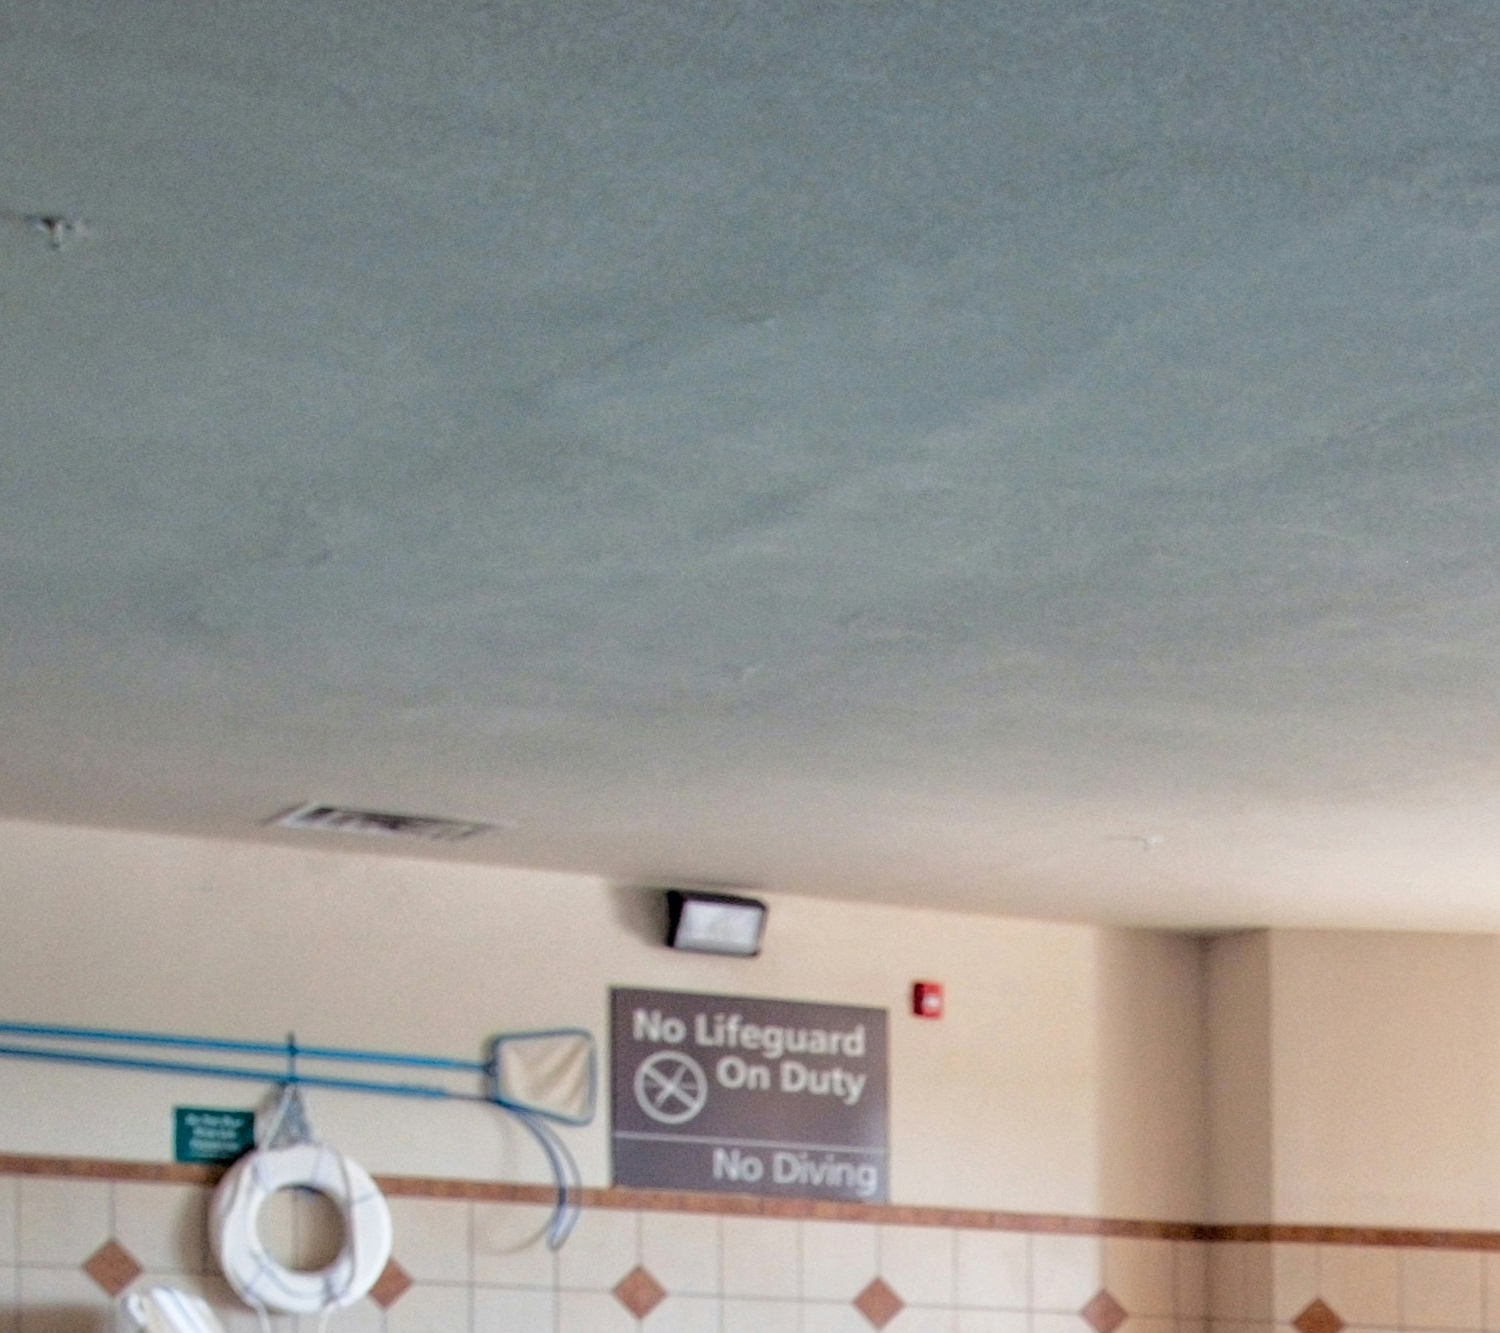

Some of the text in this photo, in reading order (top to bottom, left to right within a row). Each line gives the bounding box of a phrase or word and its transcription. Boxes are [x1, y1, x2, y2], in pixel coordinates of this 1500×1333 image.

[632, 1008, 866, 1059] No Lifeguard
[716, 1055, 866, 1106] On Duty
[712, 1147, 879, 1198] No Diving
